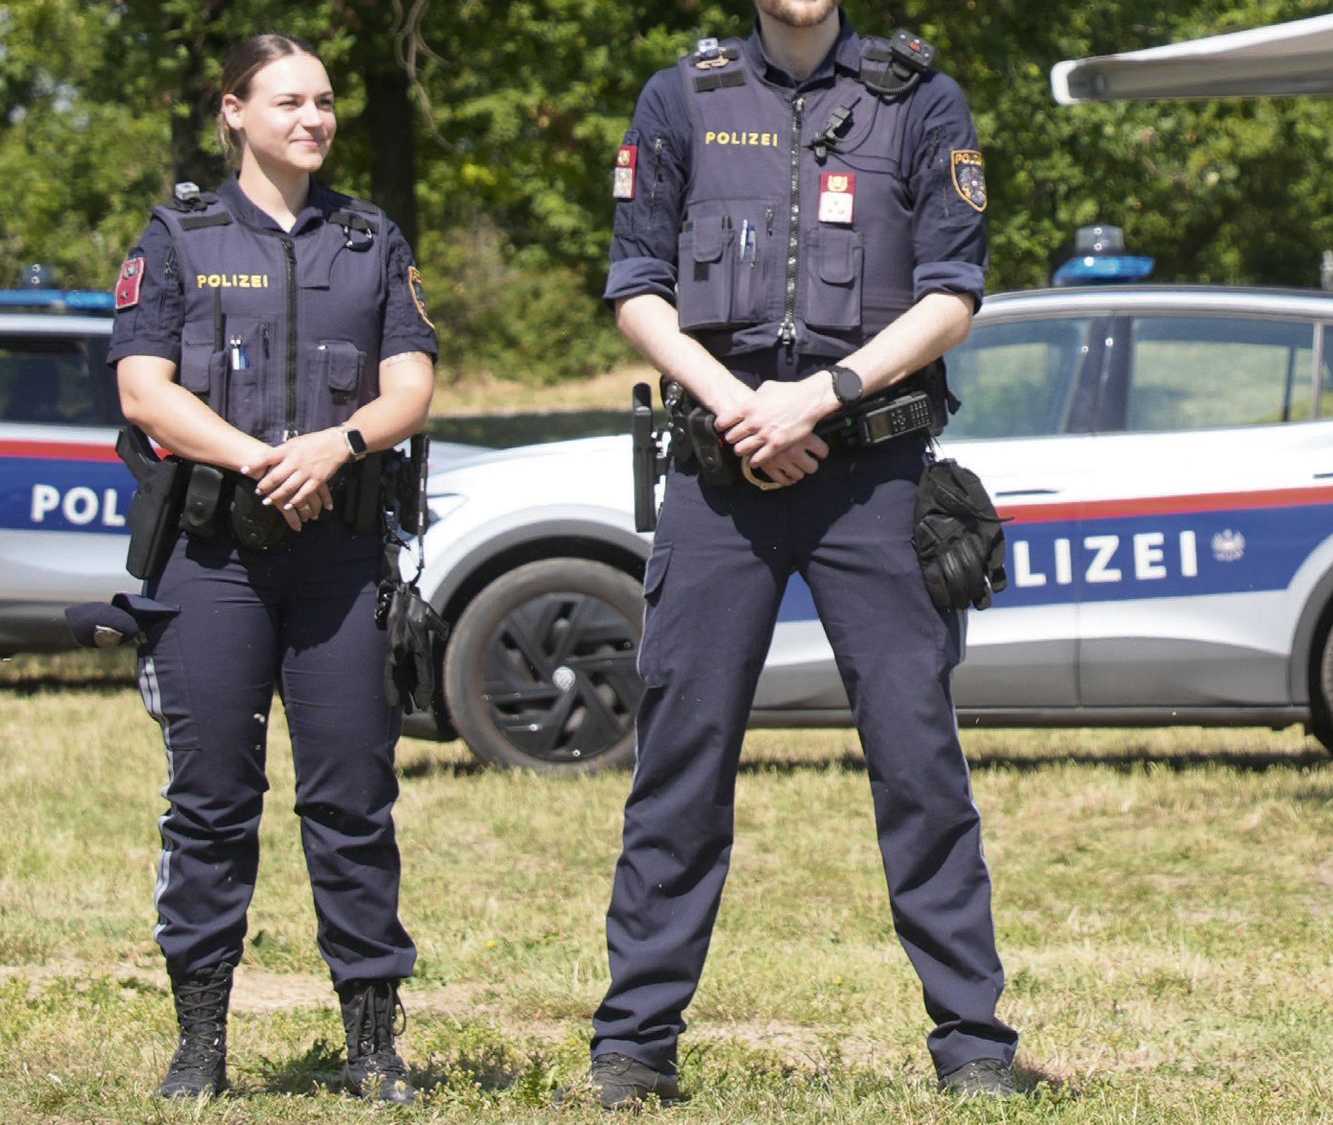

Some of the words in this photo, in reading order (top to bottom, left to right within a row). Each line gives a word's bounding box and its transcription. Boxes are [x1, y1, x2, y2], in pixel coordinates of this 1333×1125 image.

[705, 131, 779, 147] POLIZEI
[196, 274, 268, 288] POLIZEI
[30, 483, 138, 527] POL
[1013, 530, 1198, 588] LIZEI
